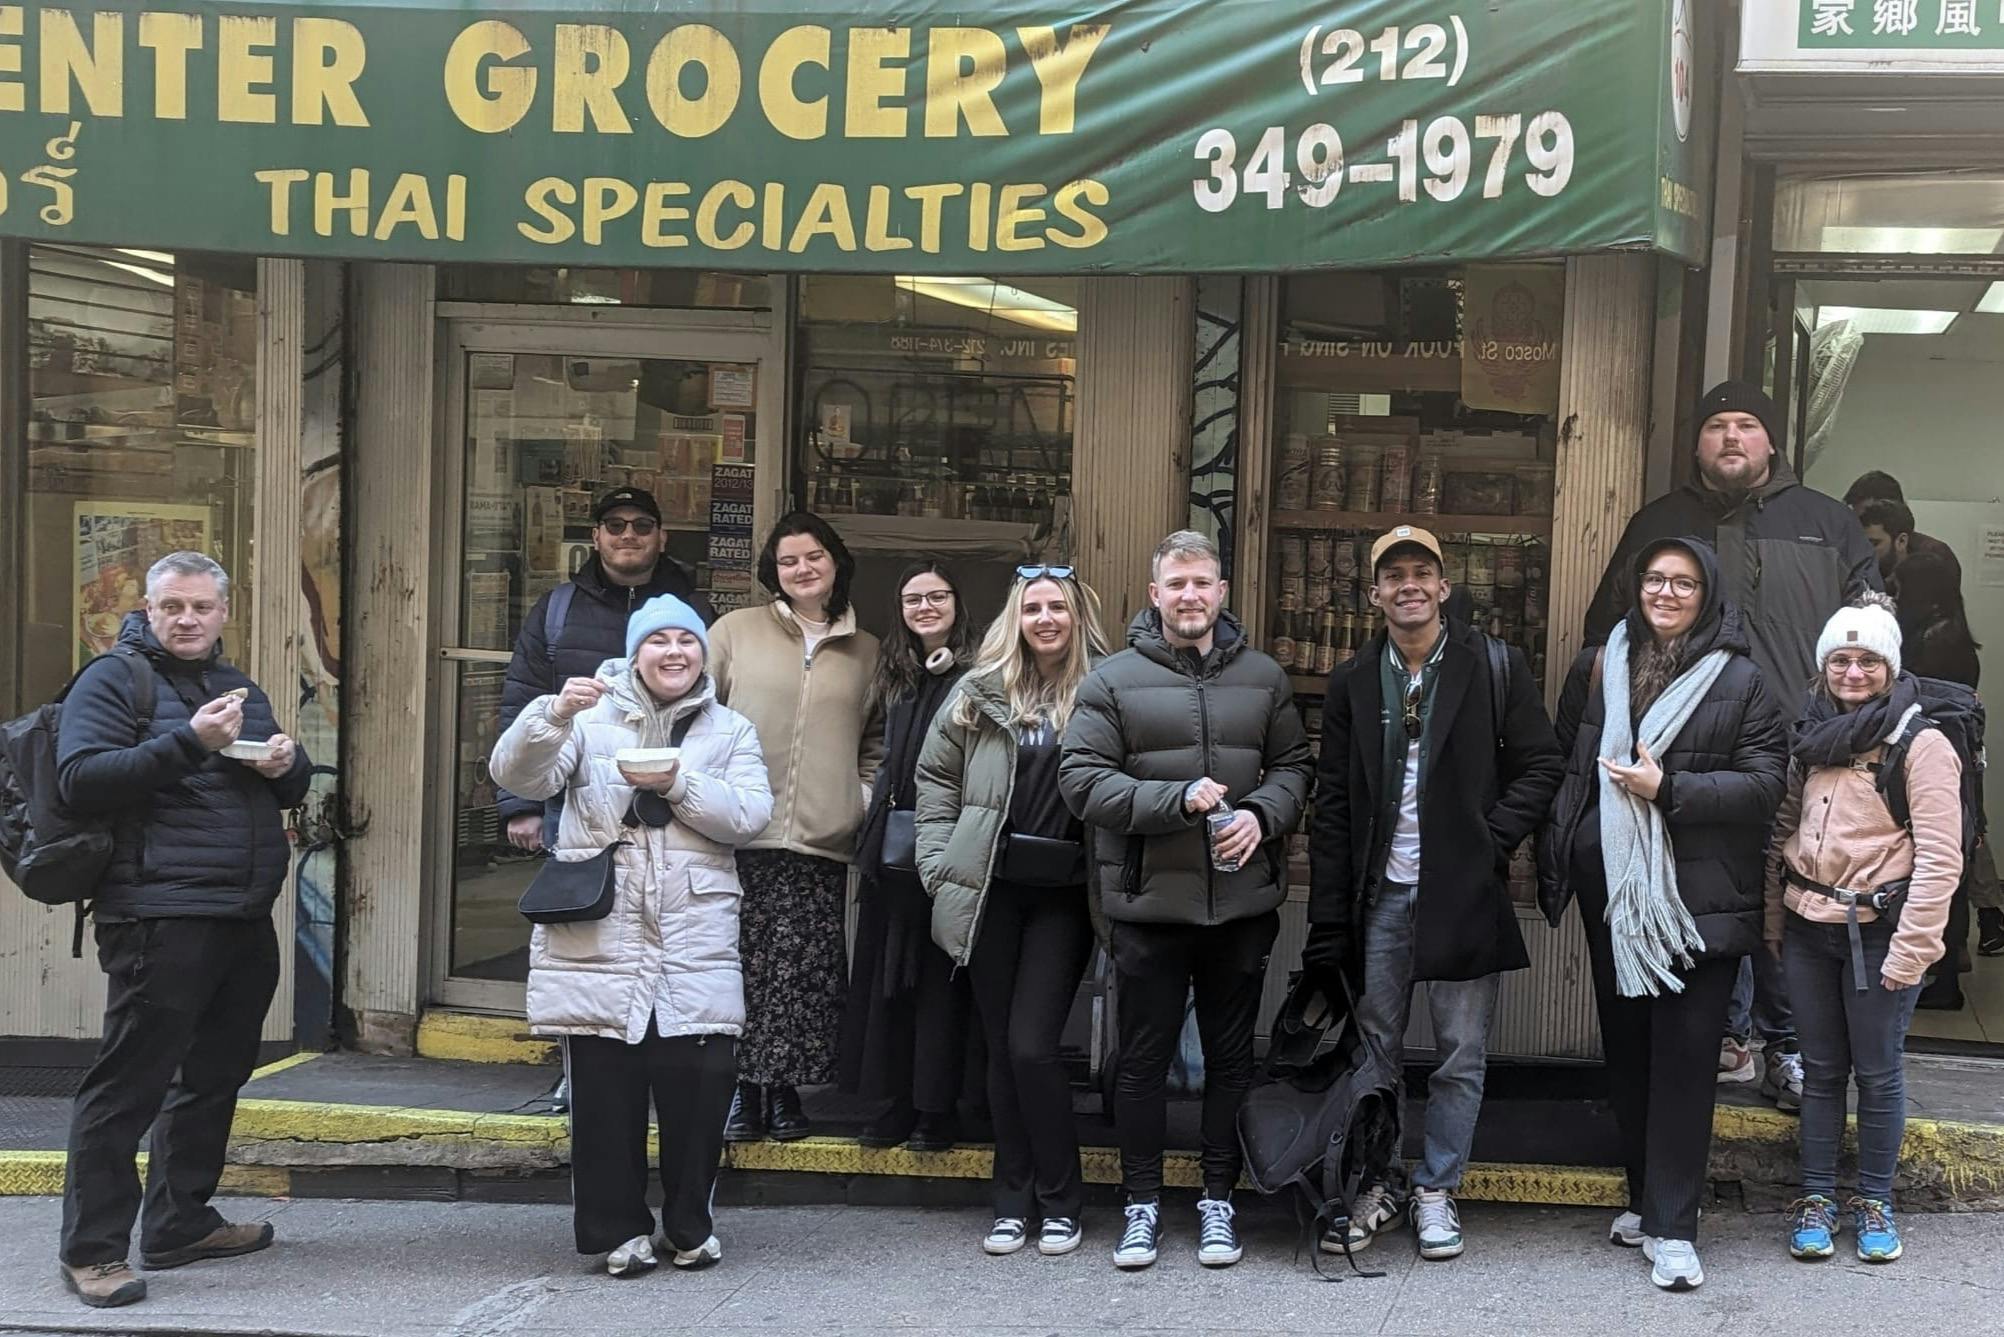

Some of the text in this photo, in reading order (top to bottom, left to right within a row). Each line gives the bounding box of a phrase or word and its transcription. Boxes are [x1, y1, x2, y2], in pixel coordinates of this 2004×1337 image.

[1300, 15, 1469, 95] (212)
[444, 20, 1111, 140] GROCERY
[1193, 111, 1575, 212] 349-1979
[254, 168, 1111, 253] THAI SPECIALTIES
[714, 467, 754, 478] ZAGAT
[714, 478, 753, 489] 2012/13
[712, 502, 753, 513] ZAGAT
[712, 514, 753, 525] RATED
[709, 537, 751, 547] ZAGAT
[709, 547, 751, 559] RATED
